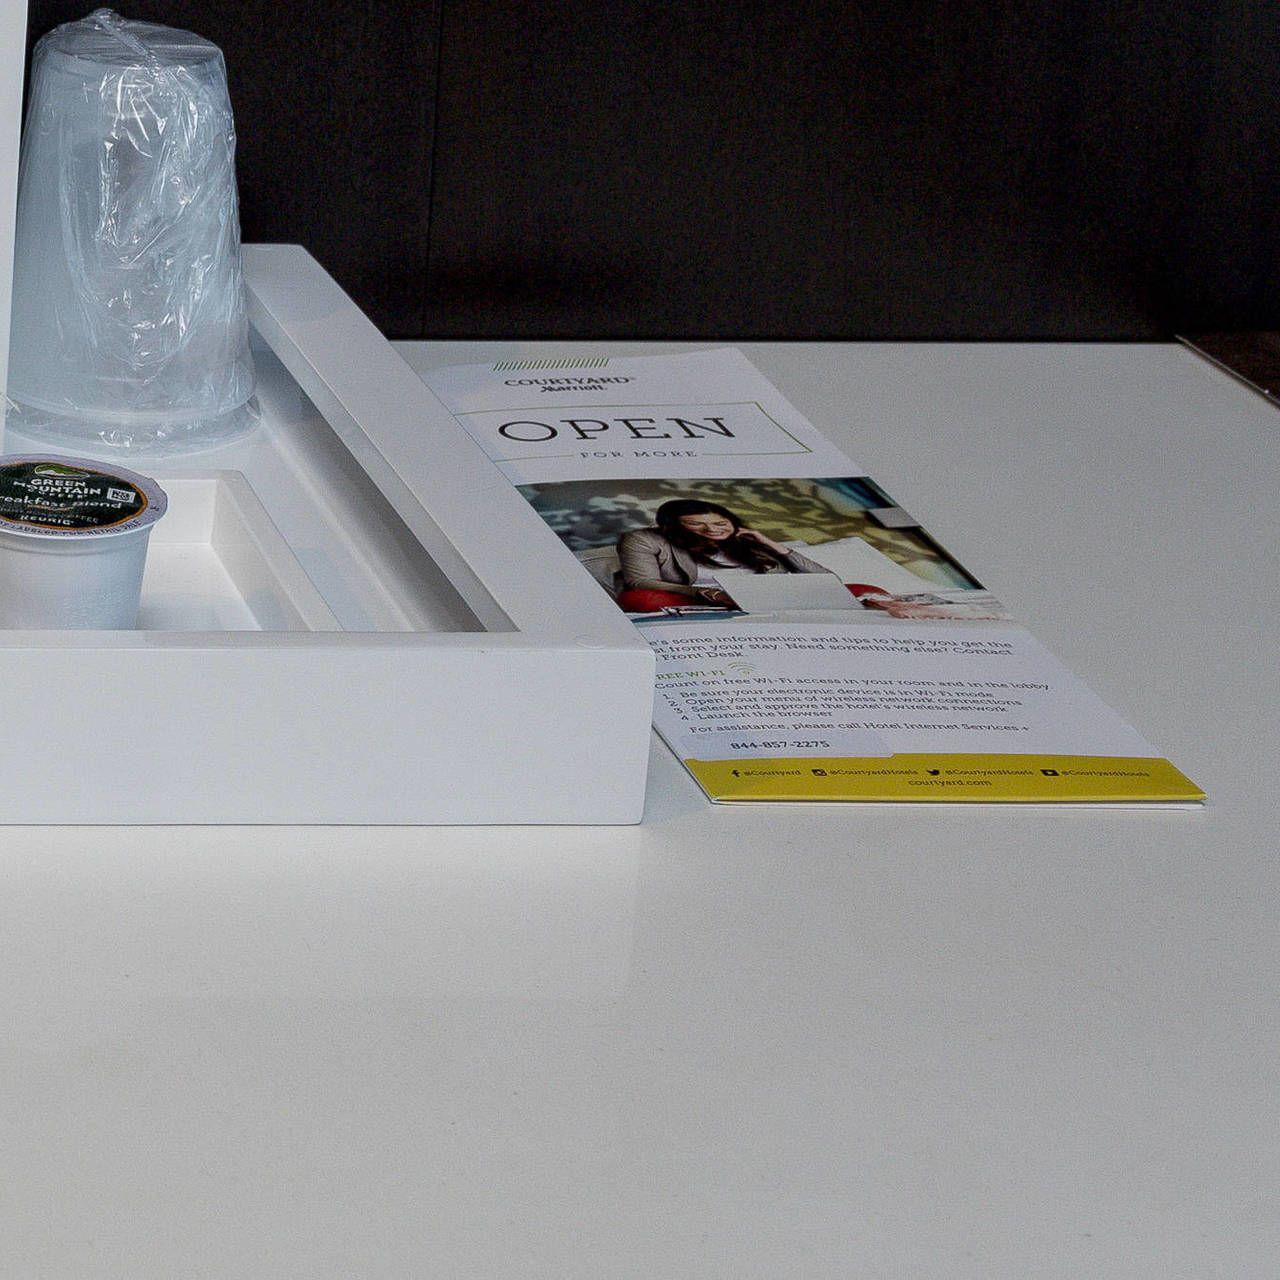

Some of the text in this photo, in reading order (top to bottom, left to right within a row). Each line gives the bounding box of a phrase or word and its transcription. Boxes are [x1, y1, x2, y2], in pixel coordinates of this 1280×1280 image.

[504, 376, 630, 387] COURTYARD
[498, 418, 736, 442] OPEN
[580, 450, 698, 459] FOR MORE
[30, 478, 86, 487] GREEN
[717, 635, 806, 643] information
[668, 644, 707, 652] from
[662, 652, 702, 660] Front
[654, 680, 700, 689] Count
[723, 677, 751, 685] free
[685, 697, 724, 705] Open
[697, 712, 754, 720] Launch
[690, 725, 712, 734] For
[792, 722, 836, 730] please
[730, 740, 830, 750] 844-857-2275
